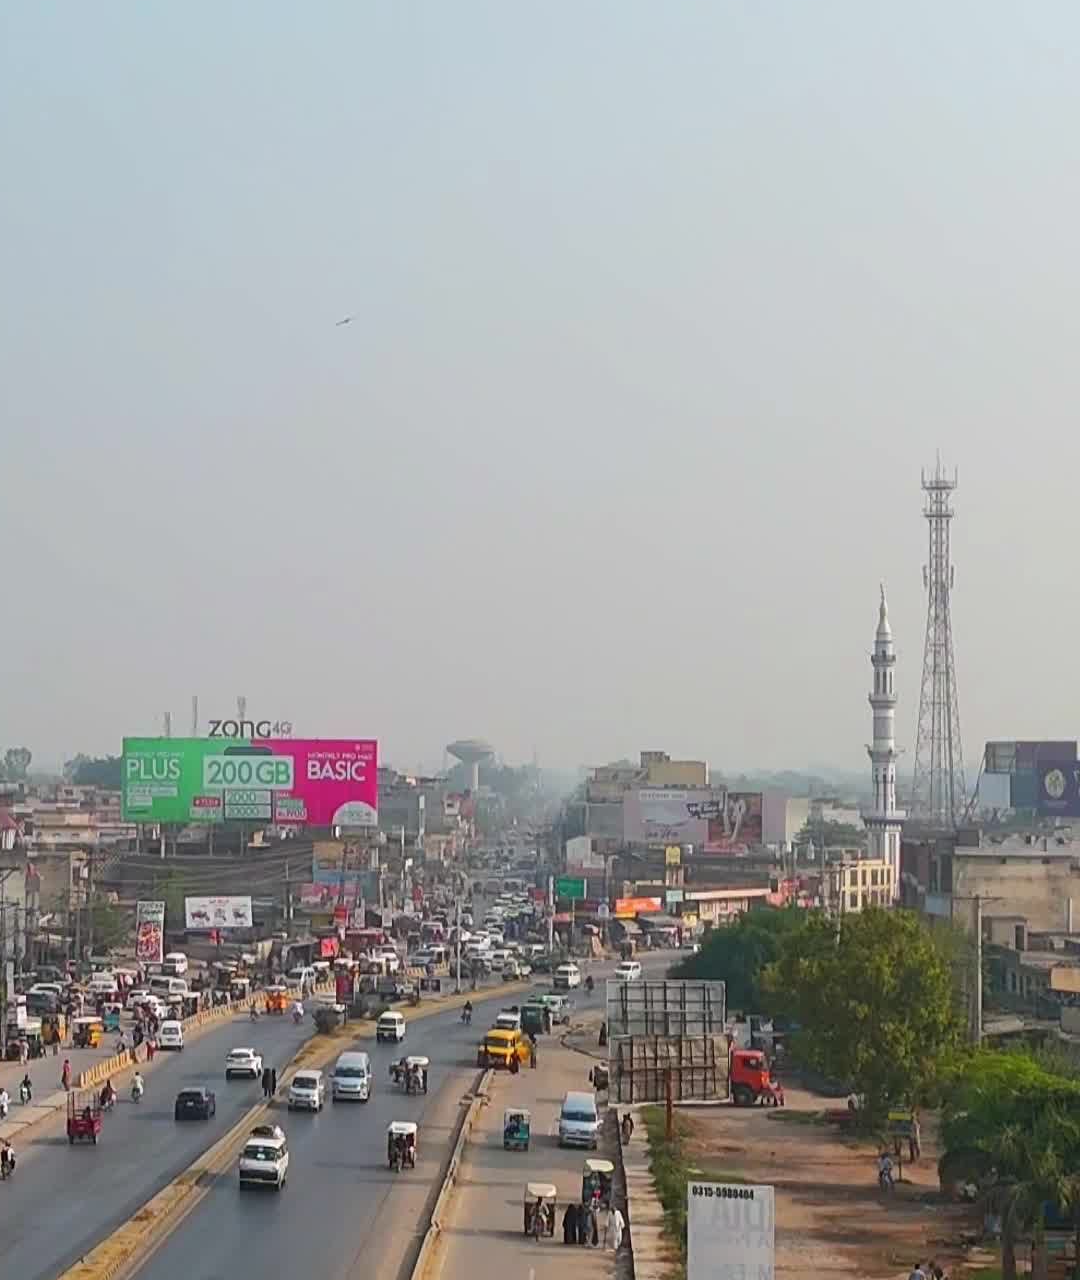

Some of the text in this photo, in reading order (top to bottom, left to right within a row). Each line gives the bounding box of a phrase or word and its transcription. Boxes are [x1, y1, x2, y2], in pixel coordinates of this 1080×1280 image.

[126, 758, 181, 780] PLUS
[207, 760, 290, 785] 200 GB
[307, 760, 367, 782] BASIC
